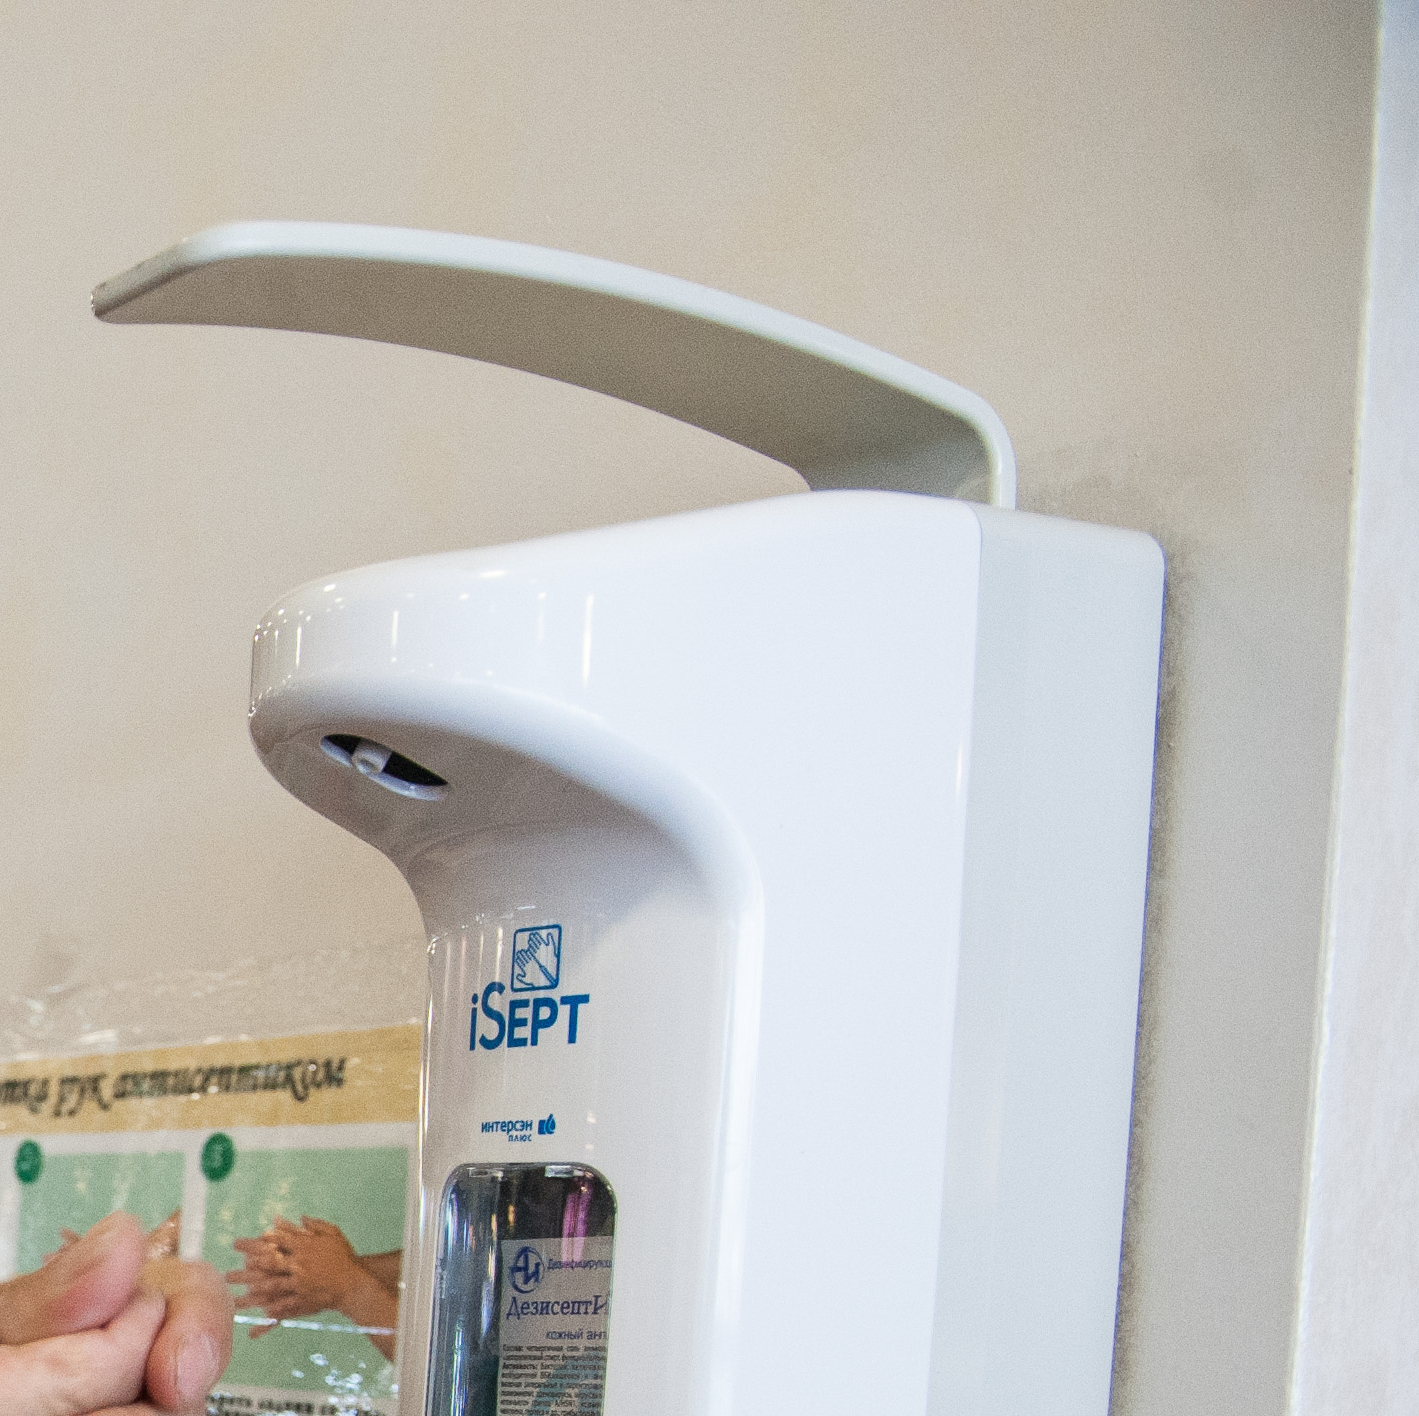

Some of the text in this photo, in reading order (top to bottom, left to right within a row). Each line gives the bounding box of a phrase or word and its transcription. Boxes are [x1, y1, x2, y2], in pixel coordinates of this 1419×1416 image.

[469, 981, 590, 1051] iSEPT
[51, 1070, 112, 1117] рук
[112, 1057, 346, 1102] антисептиком
